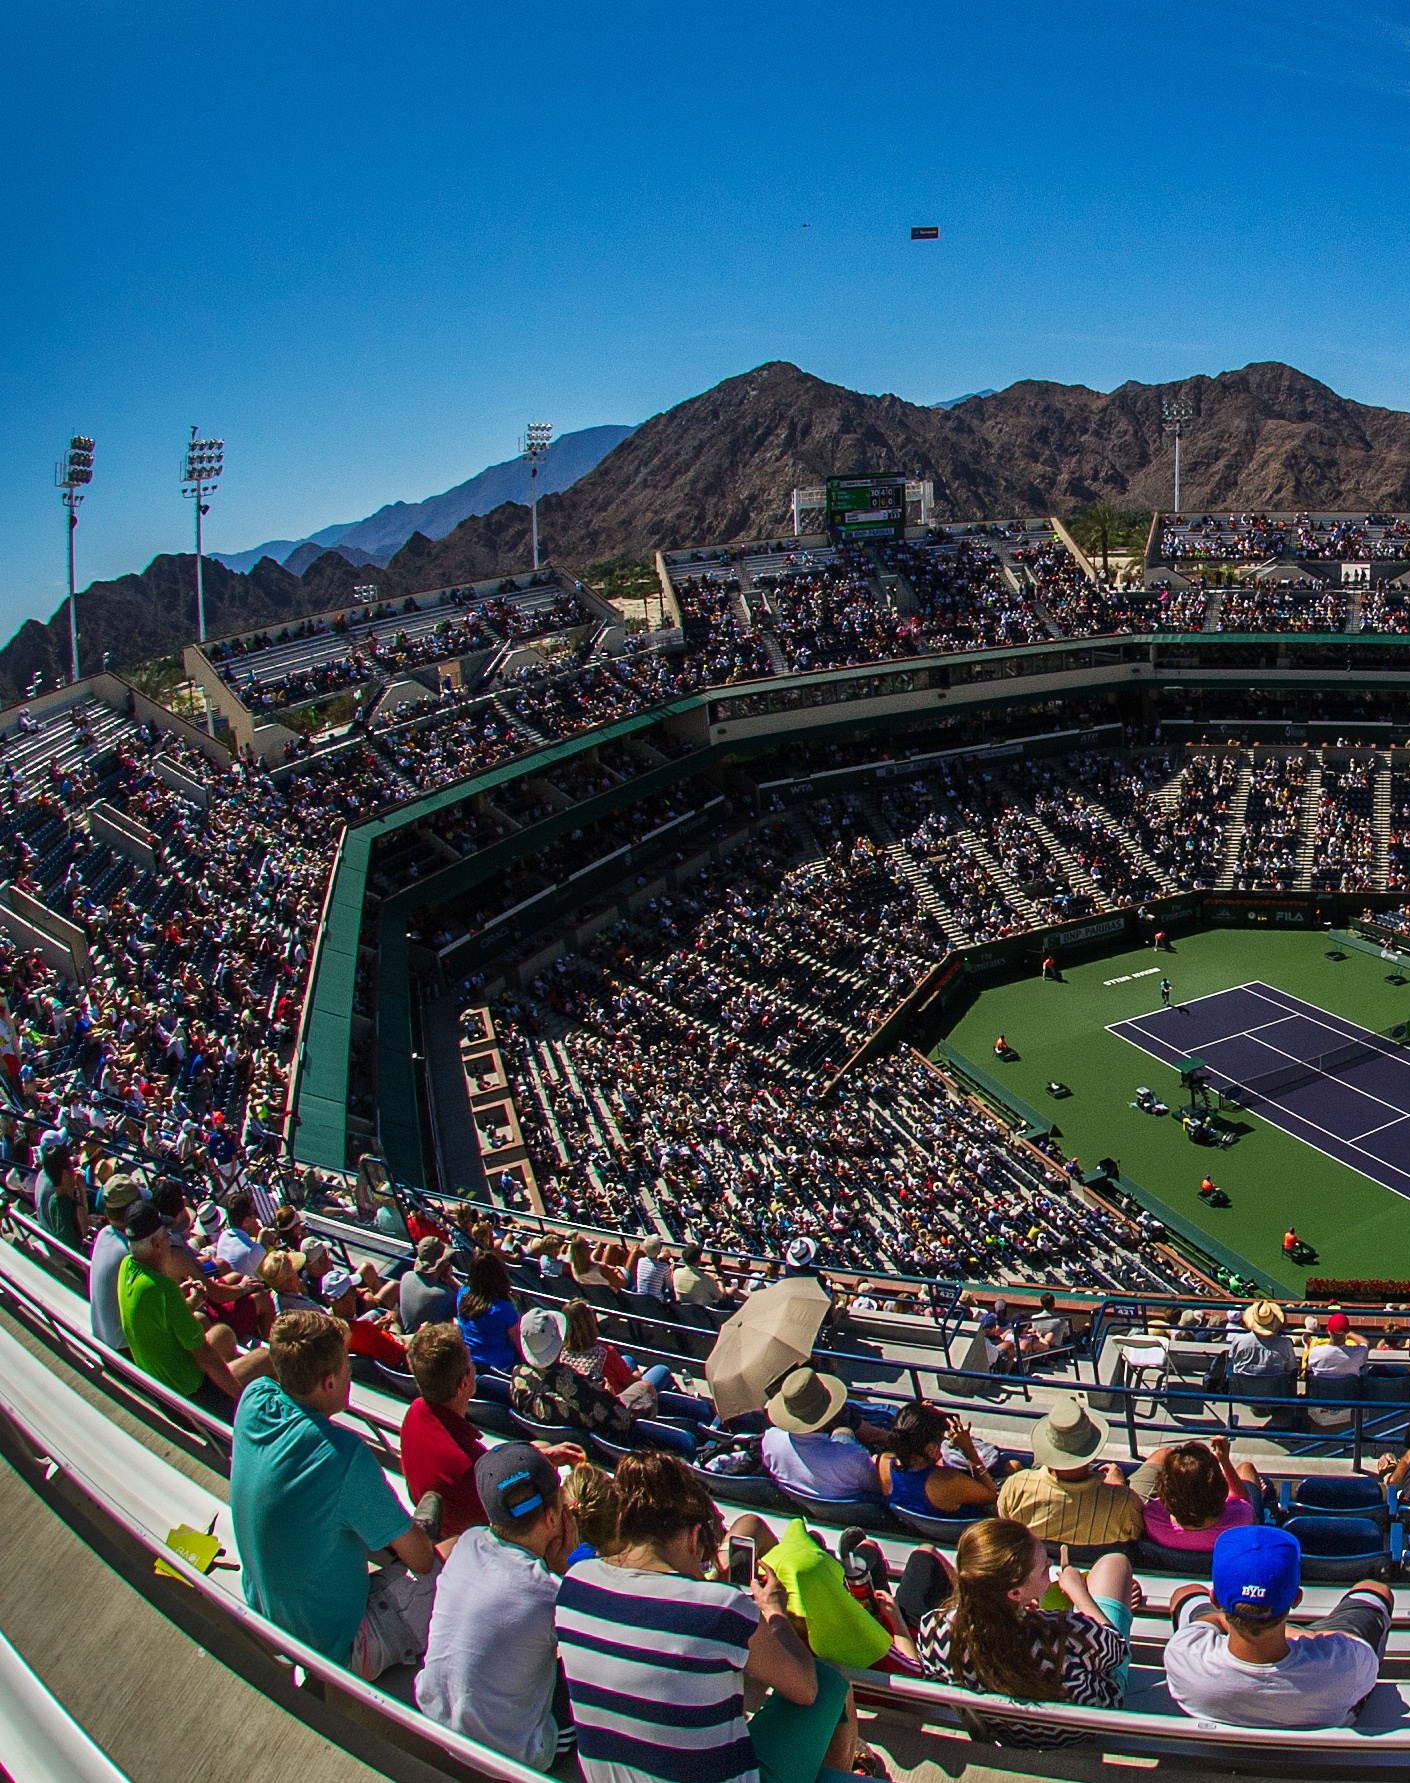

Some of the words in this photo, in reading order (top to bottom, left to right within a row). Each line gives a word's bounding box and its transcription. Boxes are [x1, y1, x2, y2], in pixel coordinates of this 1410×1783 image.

[1276, 911, 1305, 921] FILA
[1062, 928, 1082, 944] BNP
[1084, 918, 1124, 939] PARIBAS
[1241, 1585, 1266, 1598] BYU
